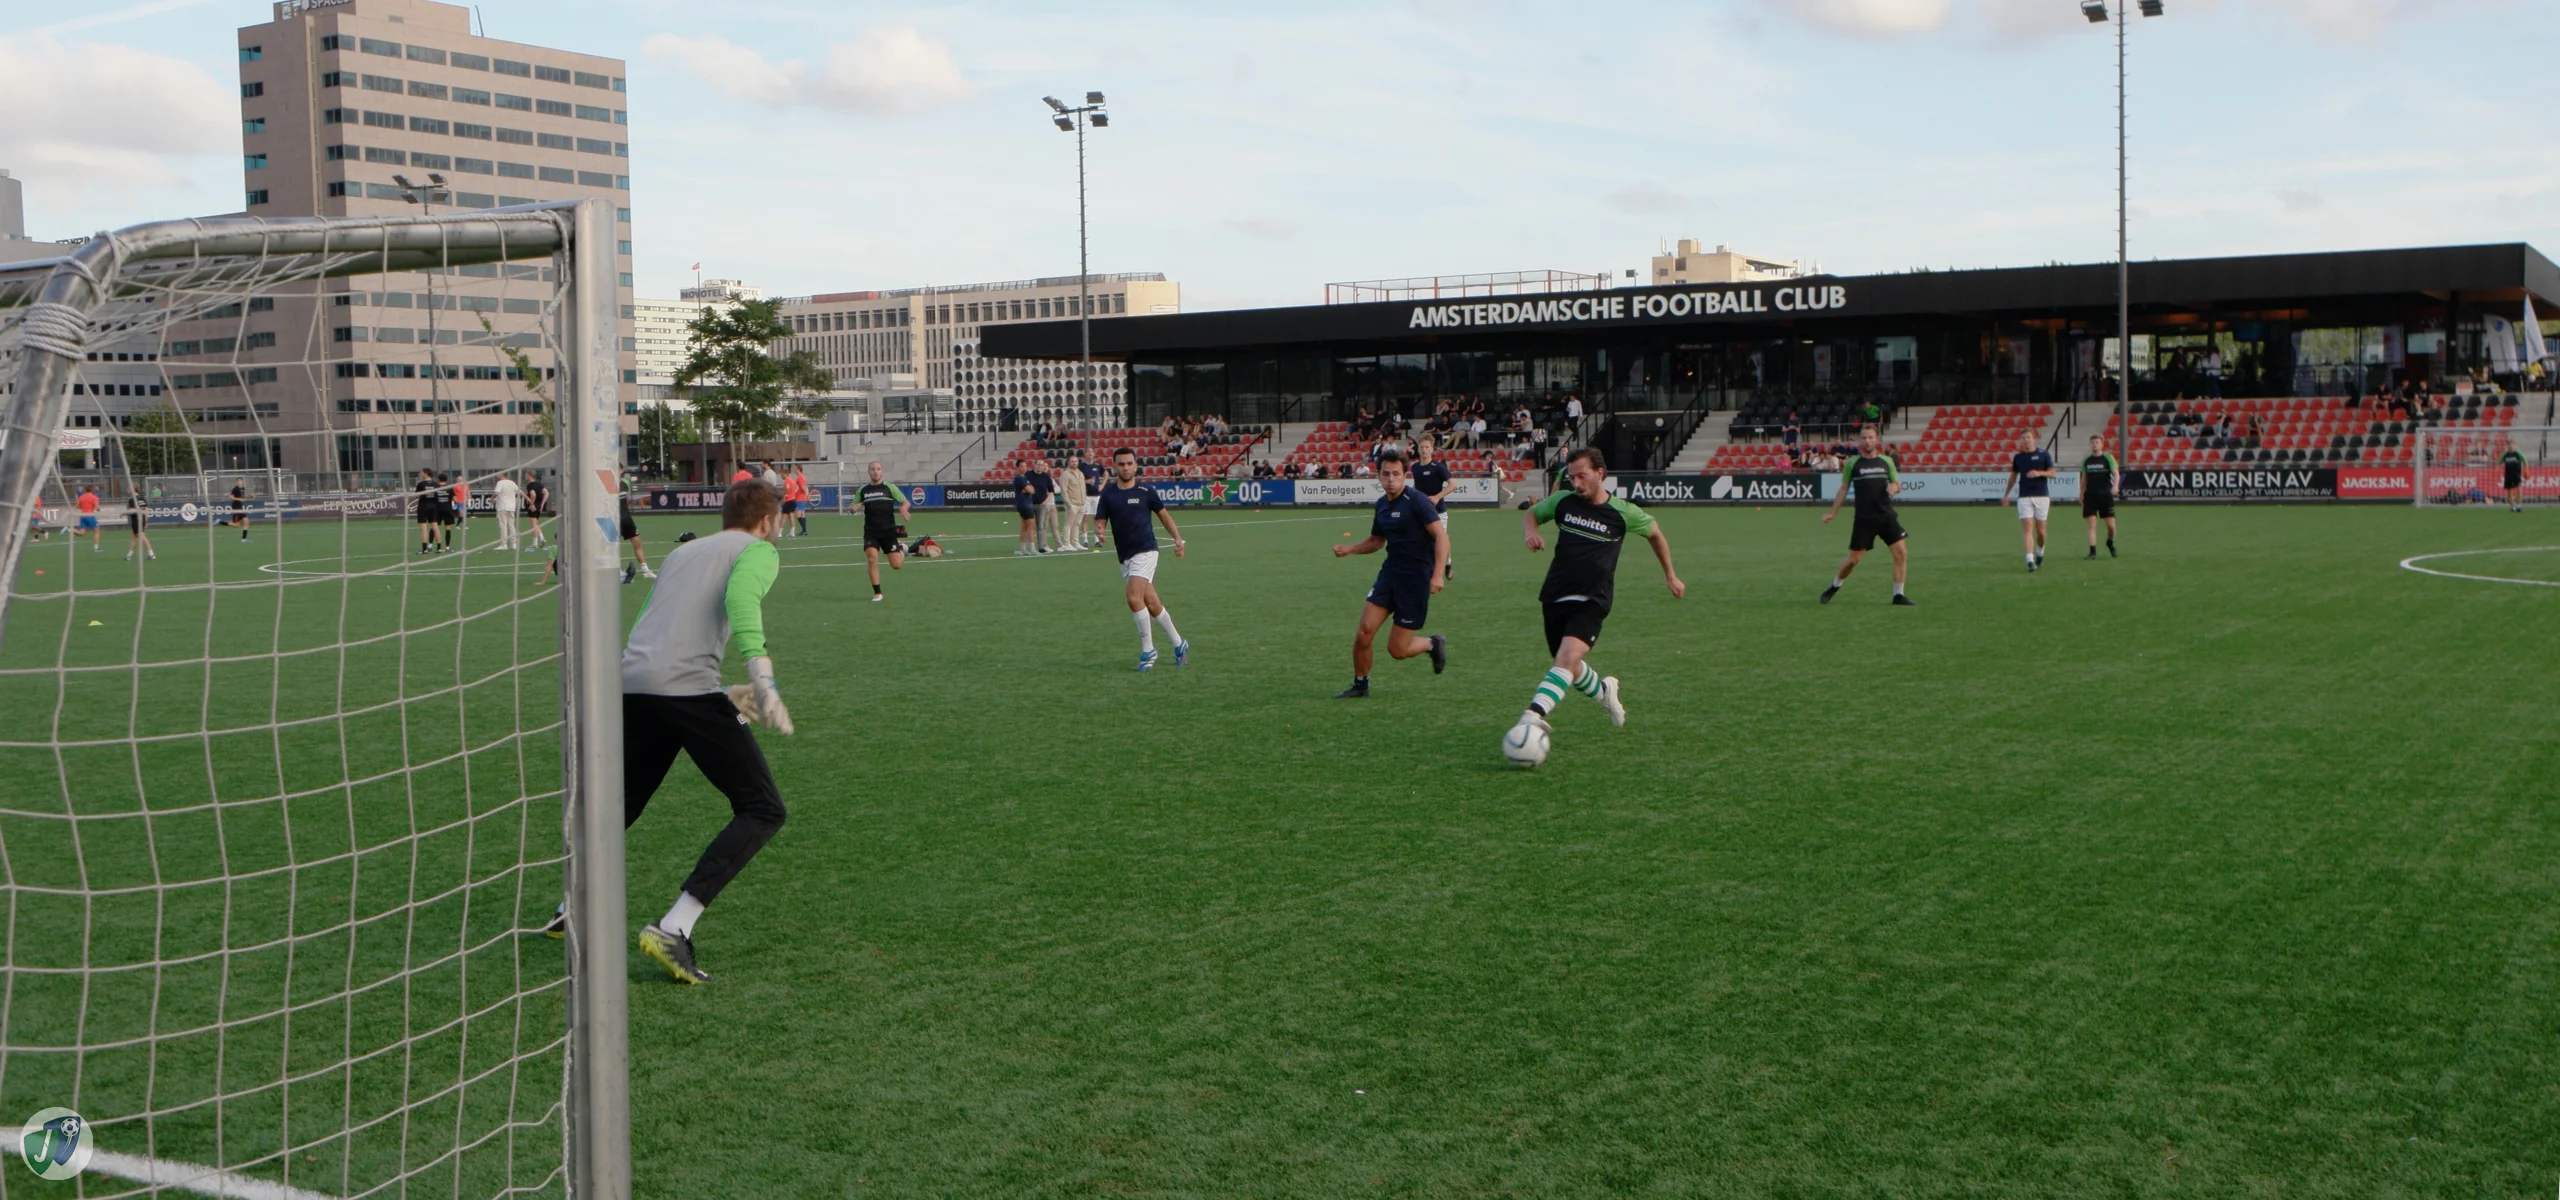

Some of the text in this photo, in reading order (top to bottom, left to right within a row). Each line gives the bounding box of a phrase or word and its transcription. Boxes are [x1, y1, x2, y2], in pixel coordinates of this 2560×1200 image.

[680, 289, 723, 299] NOVOTEL
[1409, 285, 1847, 328] AMSTERDAMSCHE FOOTBALL CLUB
[1901, 481, 1925, 491] OUP
[1950, 476, 1968, 486] Uw
[2143, 471, 2313, 488] VAN BRIENEN AV
[2342, 476, 2410, 488] JACKS.NL
[2429, 476, 2477, 488] SPORTS
[946, 489, 1016, 501] Student Experien
[1155, 483, 1204, 501] neken
[1302, 484, 1365, 498] Van Poelgeest
[1630, 481, 1694, 499] Atabix
[1747, 480, 1813, 499] Atabix
[2121, 487, 2332, 497] SCHITTERT IN BEELD EN GELUID MET VAN BRIENEN AV
[676, 493, 725, 507] THE PAD
